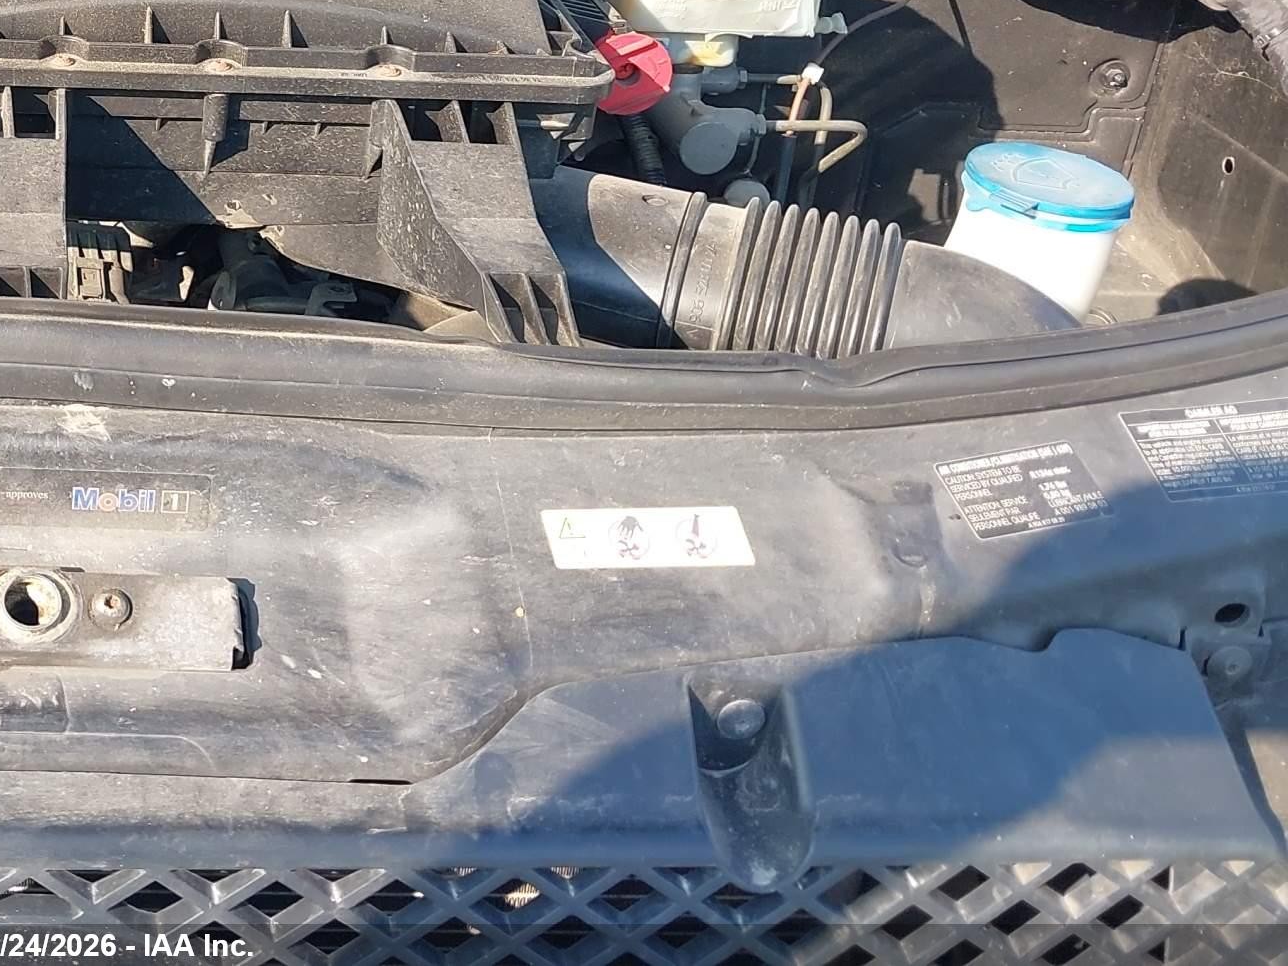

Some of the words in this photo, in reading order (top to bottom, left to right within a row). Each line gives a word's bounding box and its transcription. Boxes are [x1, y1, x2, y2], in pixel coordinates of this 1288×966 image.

[73, 488, 156, 512] Mobil
[954, 489, 993, 501] PERSONNEL
[1000, 497, 1028, 507] SERVICE
[973, 518, 1012, 531] PERSONNEL
